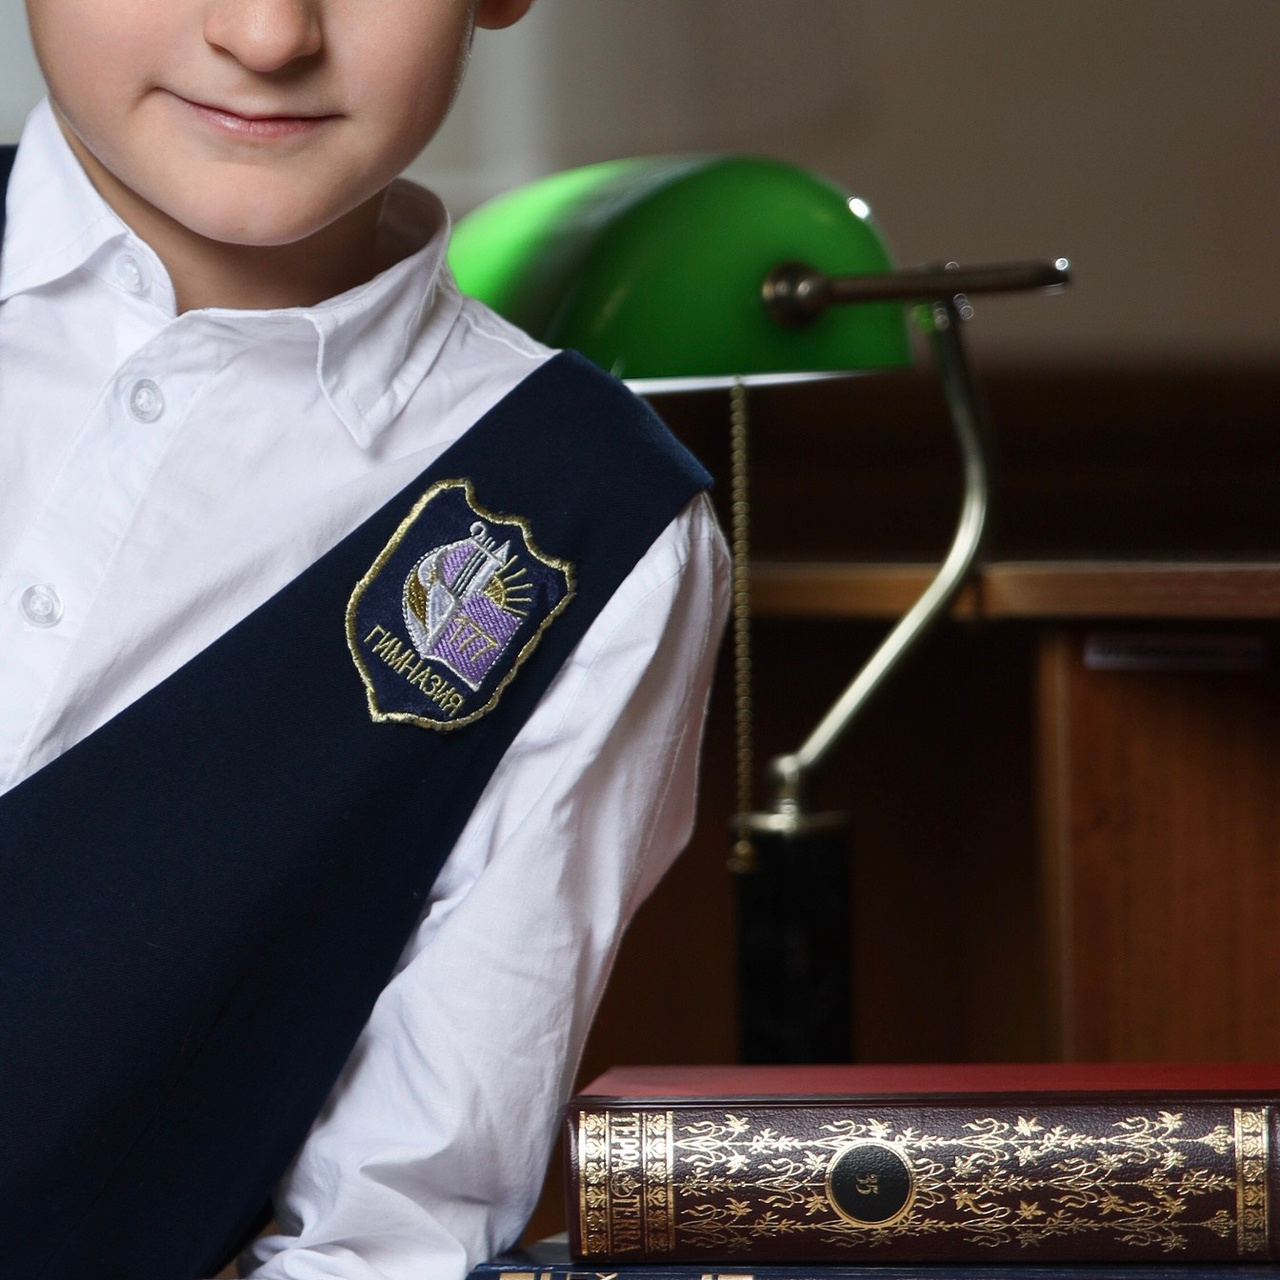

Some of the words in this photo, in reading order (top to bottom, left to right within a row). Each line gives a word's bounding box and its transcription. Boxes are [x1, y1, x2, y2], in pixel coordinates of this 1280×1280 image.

[449, 616, 499, 662] 177
[364, 624, 465, 717] ГИМНАЗИЯ
[611, 1112, 640, 1174] ТЕРРА
[856, 1173, 878, 1194] 35
[612, 1194, 641, 1253] TERRA
